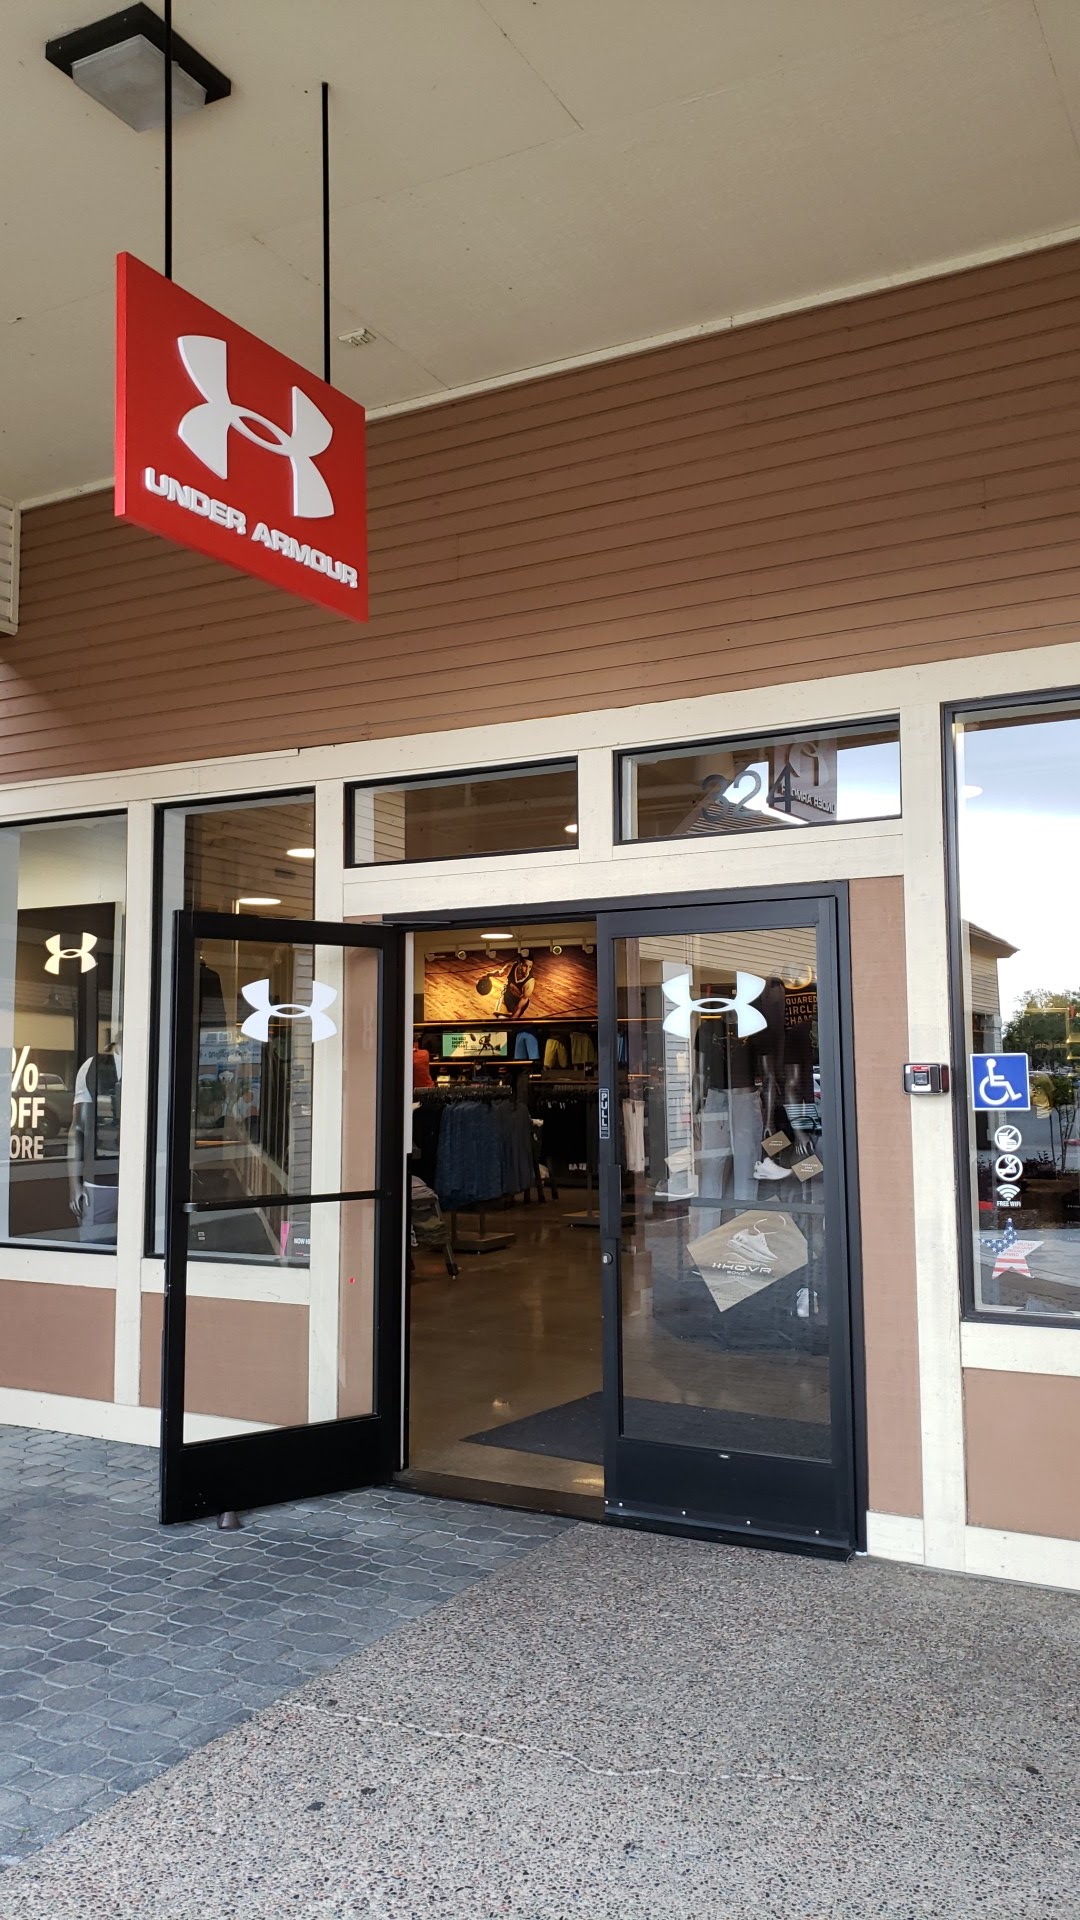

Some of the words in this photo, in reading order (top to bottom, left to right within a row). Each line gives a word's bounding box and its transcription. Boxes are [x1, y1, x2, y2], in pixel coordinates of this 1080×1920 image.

[145, 467, 246, 535] UNDER
[251, 522, 358, 589] ARMOUR
[722, 1263, 772, 1274] HOVR
